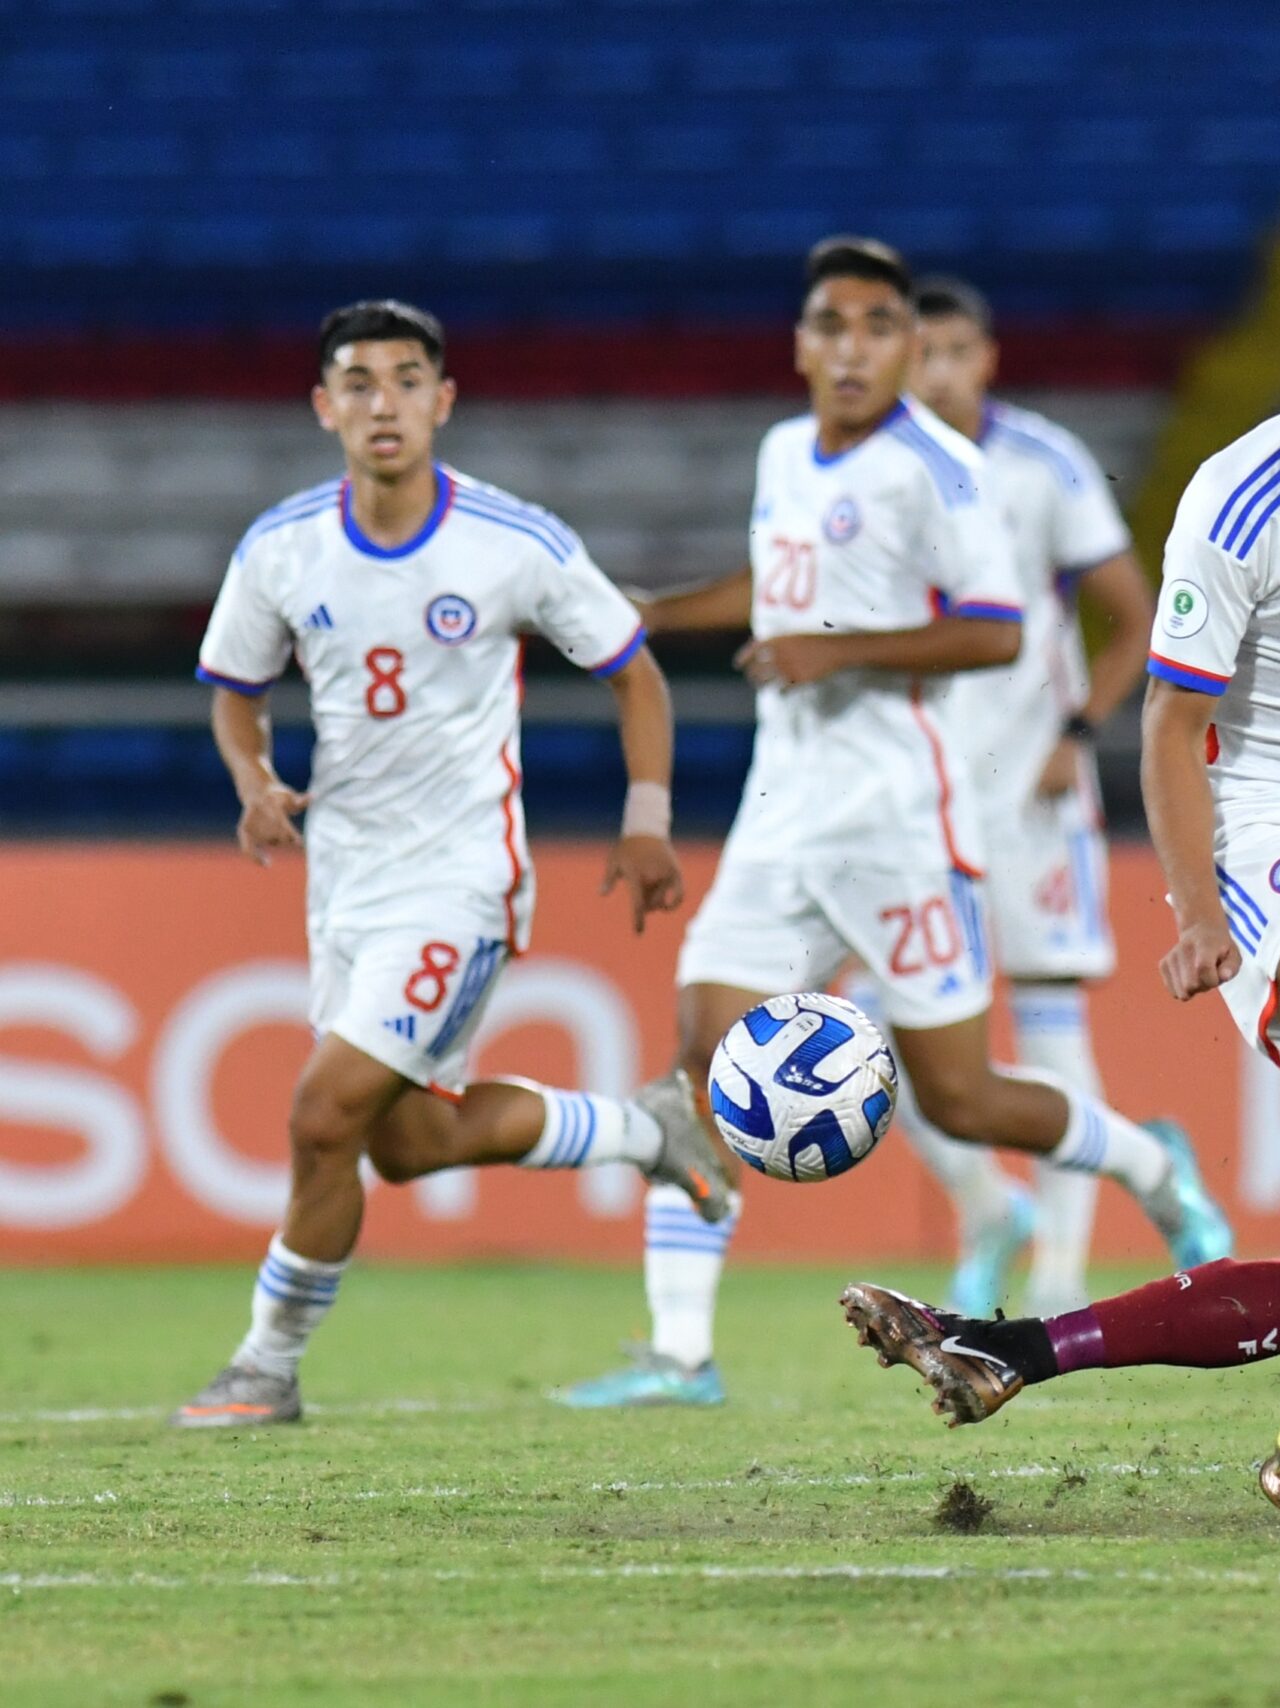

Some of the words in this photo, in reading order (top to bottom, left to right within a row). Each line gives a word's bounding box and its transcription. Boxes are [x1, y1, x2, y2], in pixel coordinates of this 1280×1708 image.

[758, 537, 817, 613] 20
[365, 646, 407, 719] 8
[881, 896, 963, 977] 20
[404, 940, 461, 1014] 8
